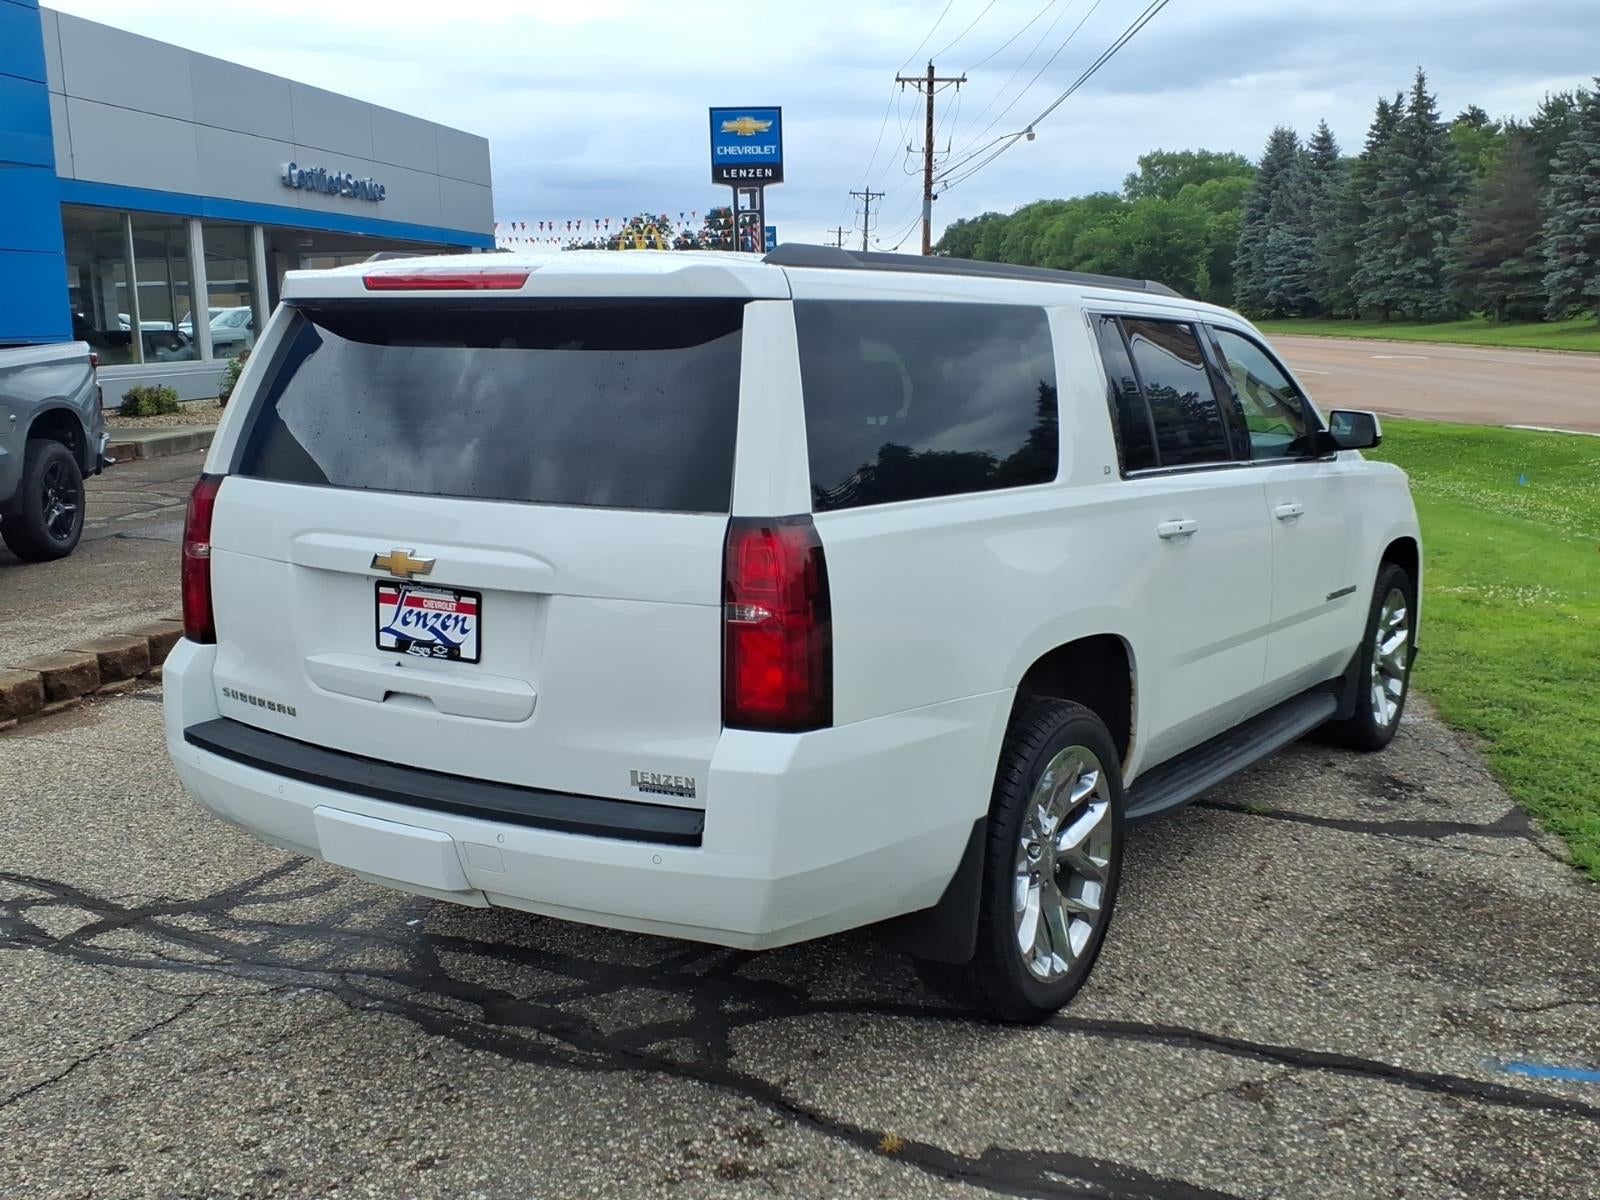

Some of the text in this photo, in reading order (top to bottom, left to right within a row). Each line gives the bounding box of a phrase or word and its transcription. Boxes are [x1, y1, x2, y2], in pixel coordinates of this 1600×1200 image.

[717, 145, 776, 155] CHEVROLET
[283, 162, 386, 201] Certified Service
[723, 168, 772, 178] LENZEN
[423, 599, 457, 612] CHEVROLET
[379, 590, 472, 646] Lenzen
[406, 640, 431, 657] Lenzen
[222, 687, 297, 717] SUBURBAN
[630, 770, 695, 789] LENZEN
